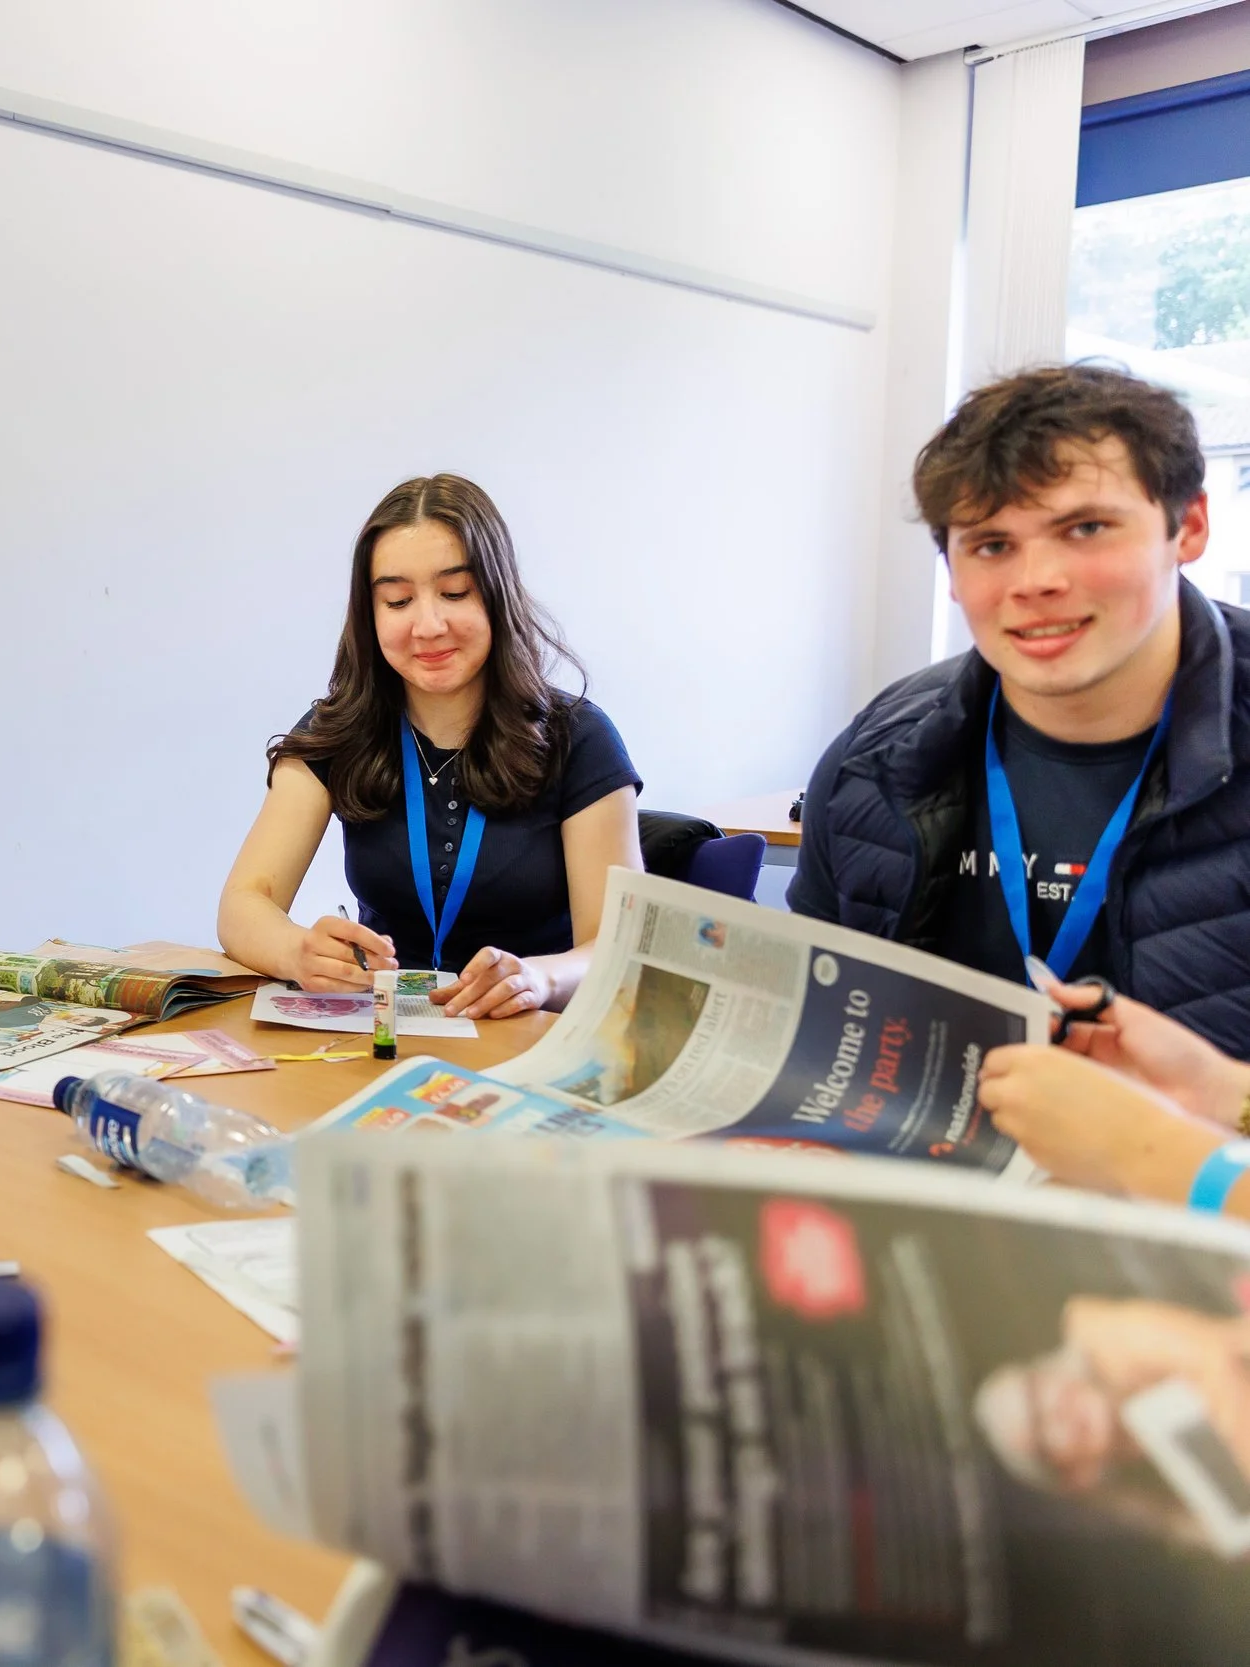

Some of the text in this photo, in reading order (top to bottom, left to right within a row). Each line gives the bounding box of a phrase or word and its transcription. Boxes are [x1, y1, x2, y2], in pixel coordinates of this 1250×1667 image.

[791, 989, 871, 1125] Welcome to
[842, 1017, 913, 1132] the party.
[945, 1042, 982, 1143] nationwide
